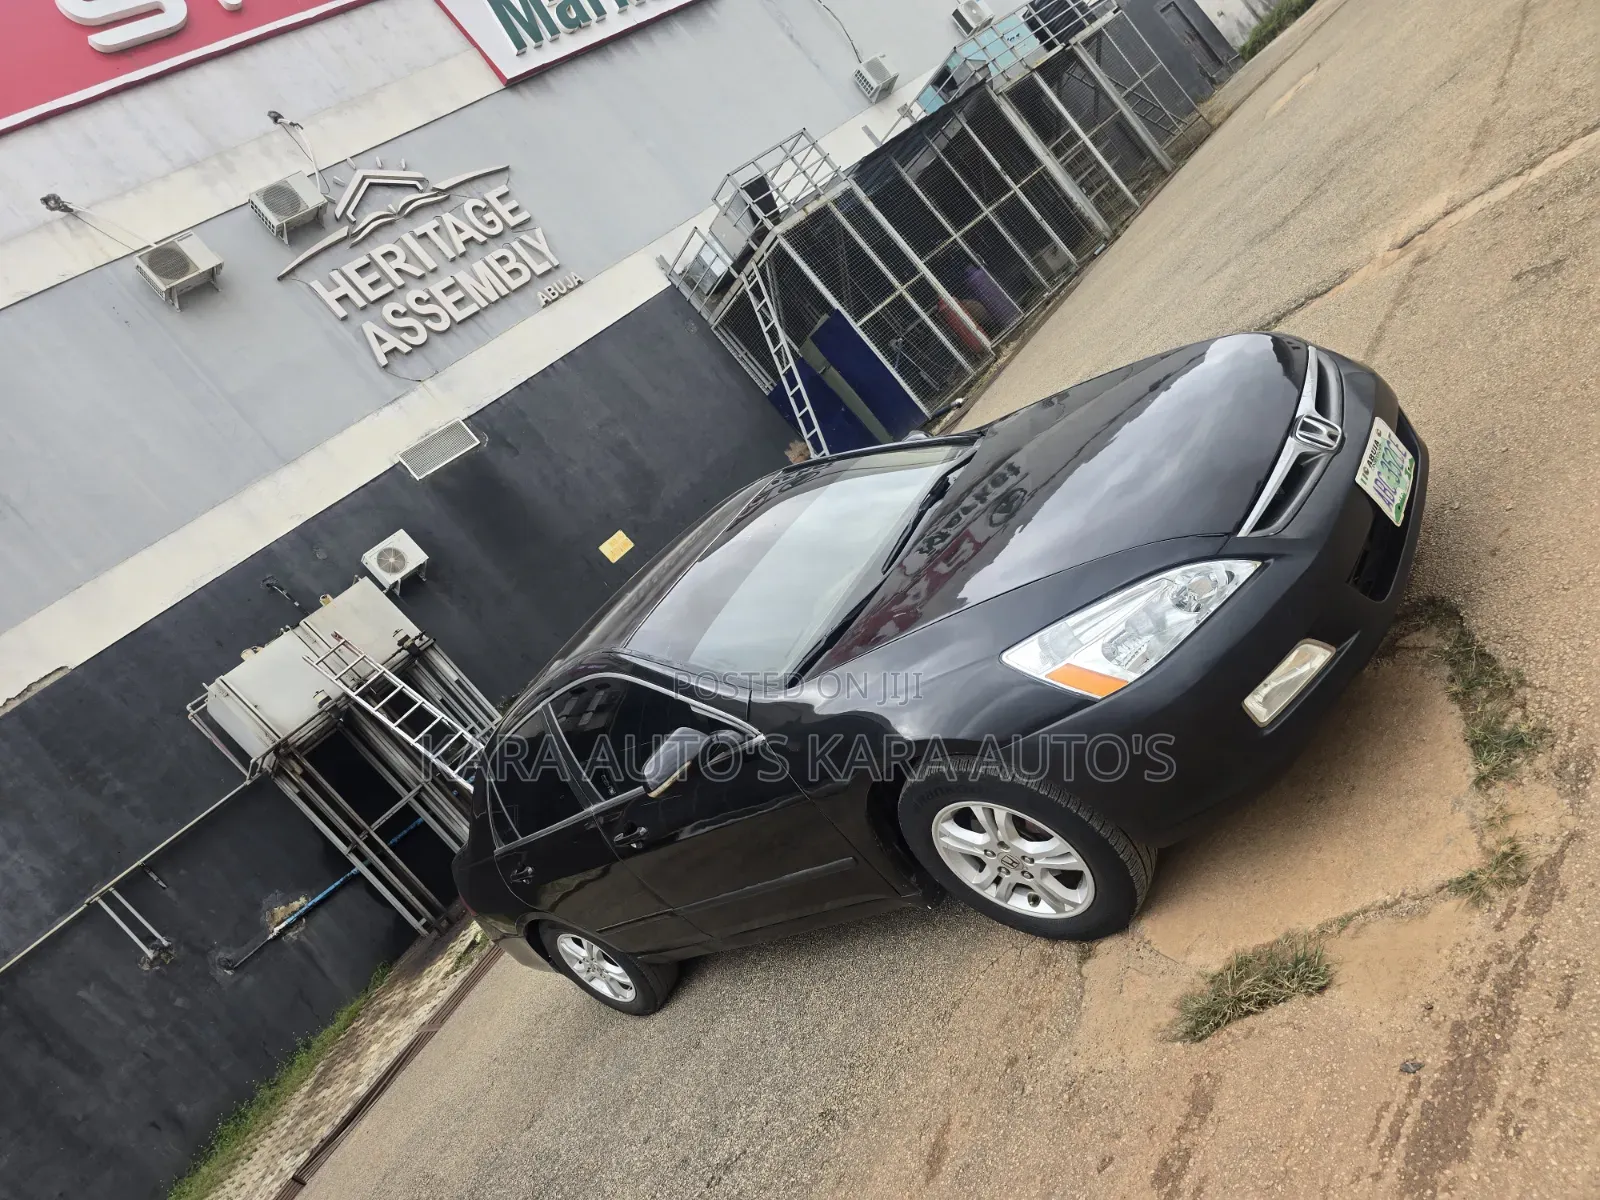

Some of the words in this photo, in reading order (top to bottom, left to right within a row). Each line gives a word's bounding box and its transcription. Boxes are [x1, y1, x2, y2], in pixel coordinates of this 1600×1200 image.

[310, 185, 531, 321] HERITAGE
[361, 227, 561, 368] ASSEMBLY
[537, 272, 584, 308] ABUJA
